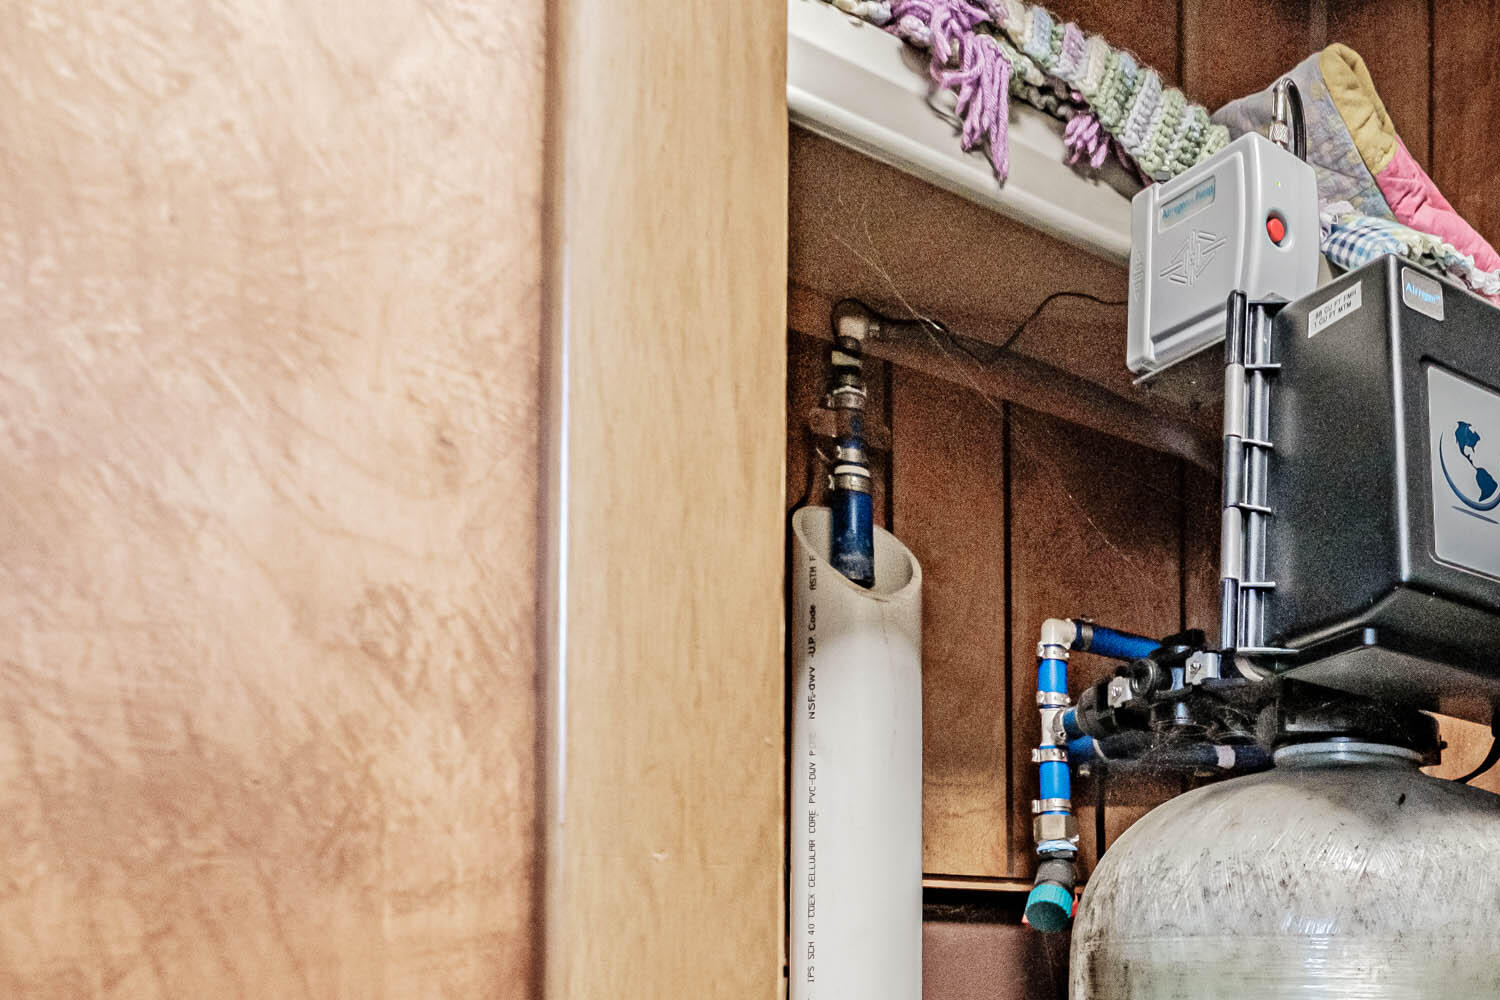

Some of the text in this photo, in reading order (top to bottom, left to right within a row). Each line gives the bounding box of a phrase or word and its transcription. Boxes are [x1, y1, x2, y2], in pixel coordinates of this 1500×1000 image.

[808, 566, 816, 590] ASTM
[808, 604, 816, 631] Code
[808, 762, 816, 804] PVC-DWV
[808, 810, 816, 833] CORE
[808, 840, 816, 888] CELLULAR
[808, 923, 815, 935] 40
[807, 942, 815, 960] SCH
[807, 966, 815, 983] IPS
